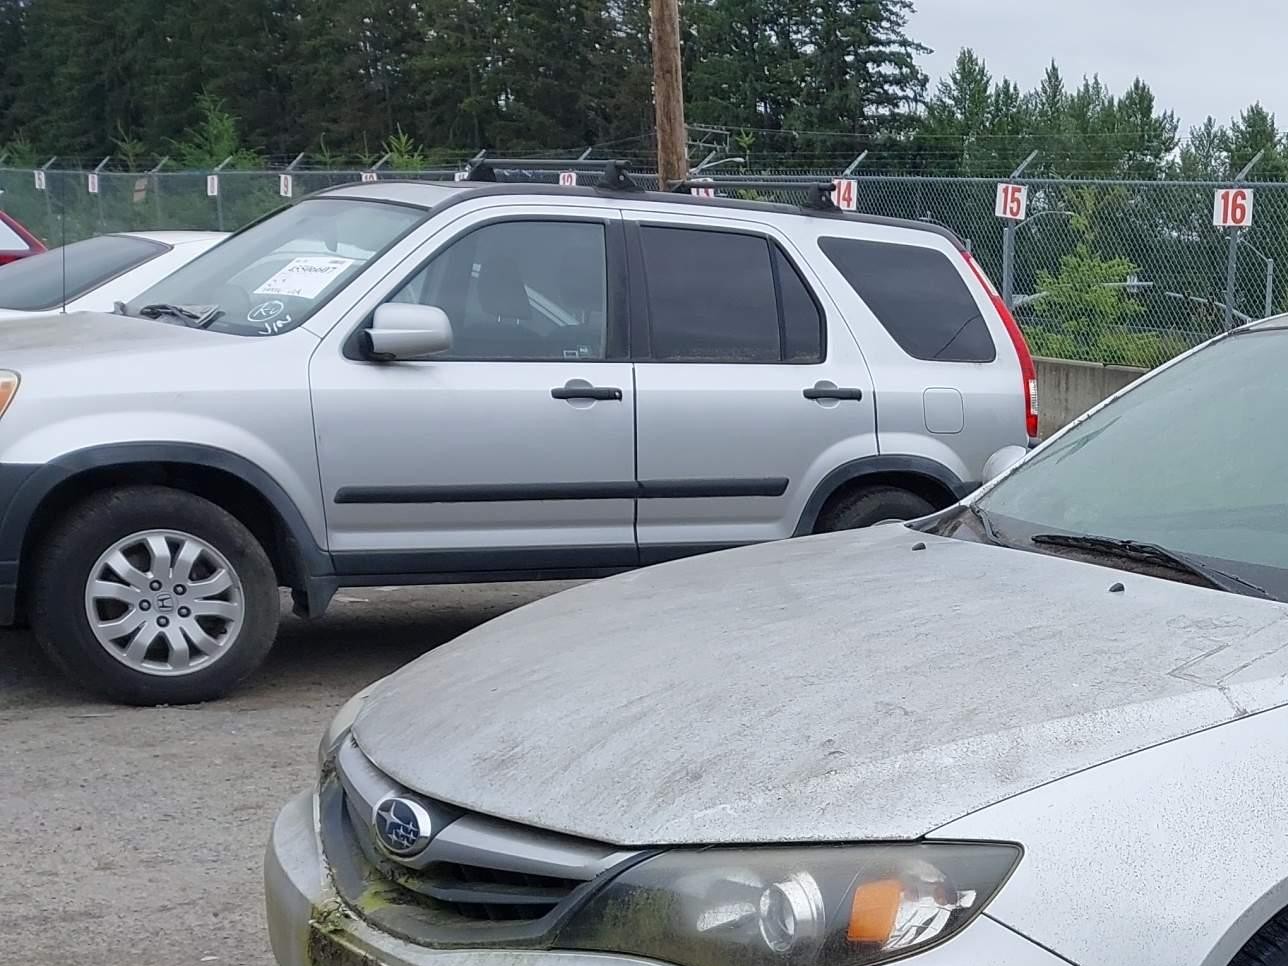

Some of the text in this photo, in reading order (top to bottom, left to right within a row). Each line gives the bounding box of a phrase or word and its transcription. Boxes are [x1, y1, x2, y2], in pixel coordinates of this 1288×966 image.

[836, 181, 852, 208] 14
[1001, 185, 1022, 218] 15
[1221, 190, 1247, 225] 16
